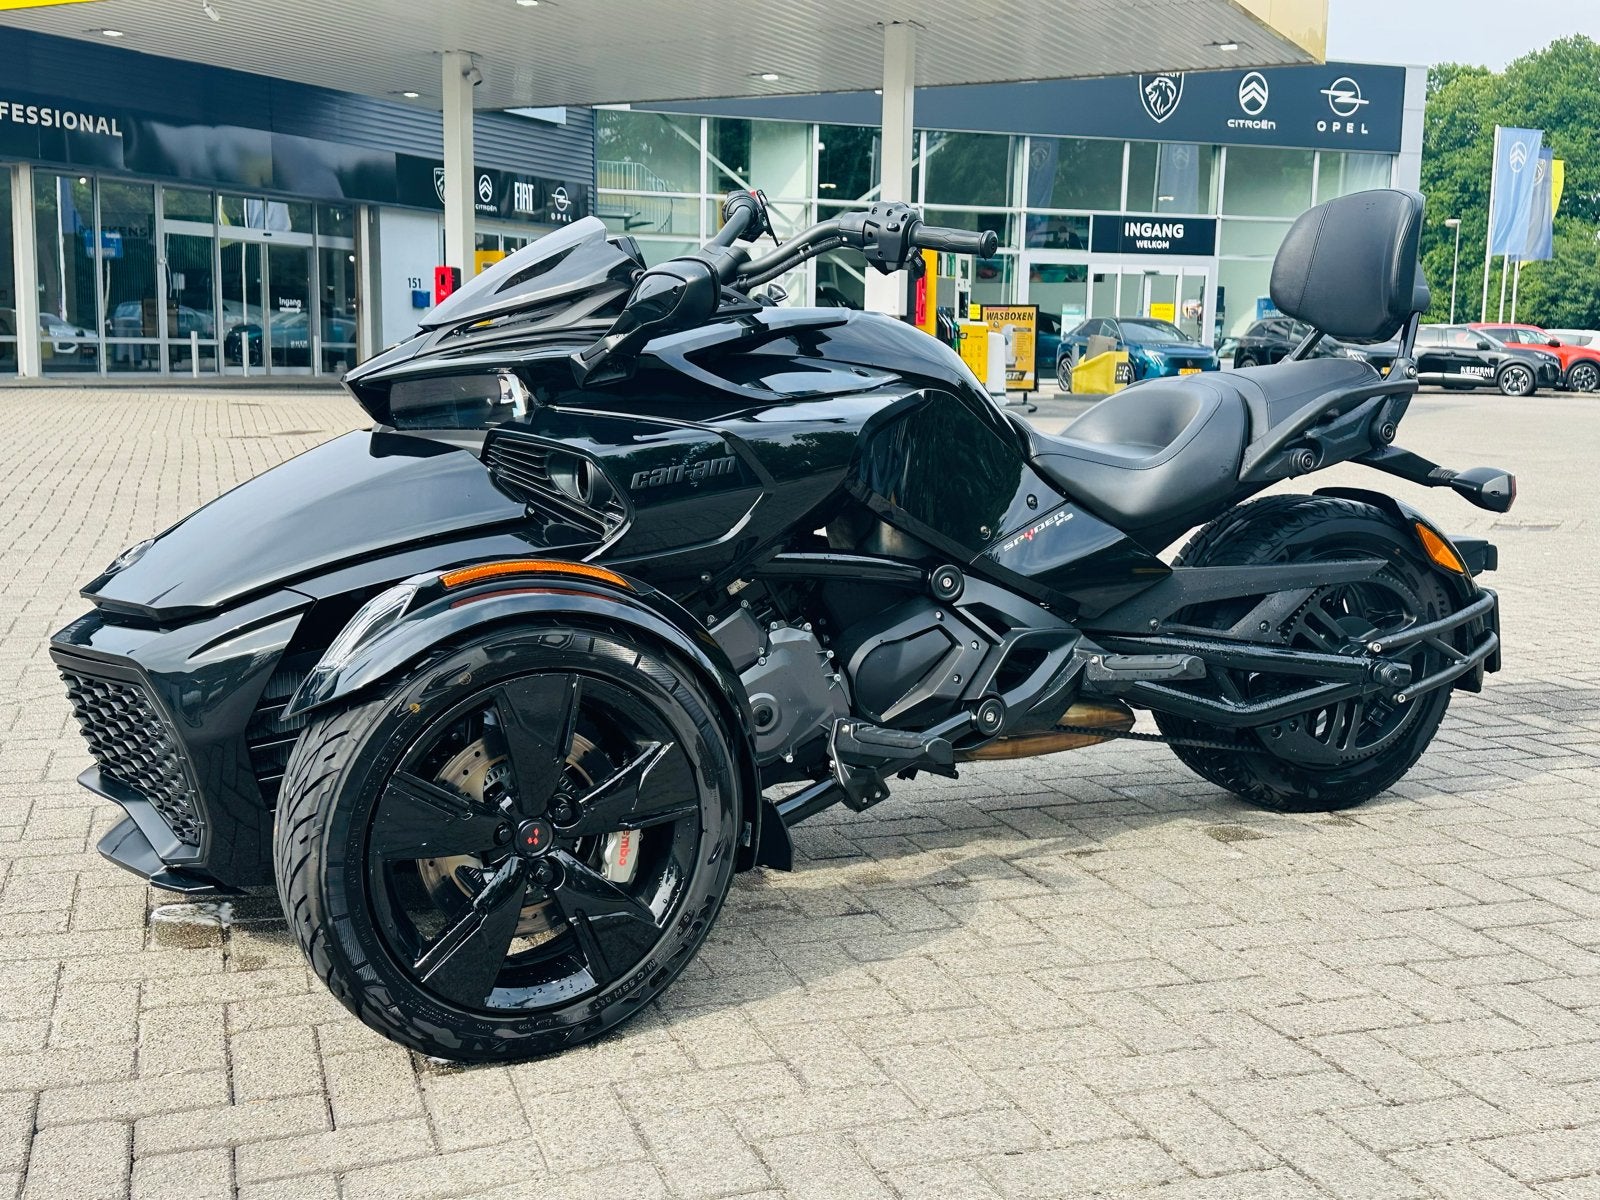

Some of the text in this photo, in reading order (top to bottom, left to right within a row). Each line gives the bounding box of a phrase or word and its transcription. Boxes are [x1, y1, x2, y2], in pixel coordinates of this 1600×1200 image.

[0, 101, 123, 137] FESSIONAL
[1316, 120, 1369, 135] OPEL
[514, 181, 534, 212] FIAT
[550, 212, 572, 223] OPEL
[1124, 222, 1184, 238] INGANG
[1136, 240, 1170, 249] WELKOM
[407, 277, 422, 289] 151
[279, 297, 301, 308] Ingang
[986, 311, 1034, 321] WASBOXEN
[1003, 510, 1066, 552] SPYDER
